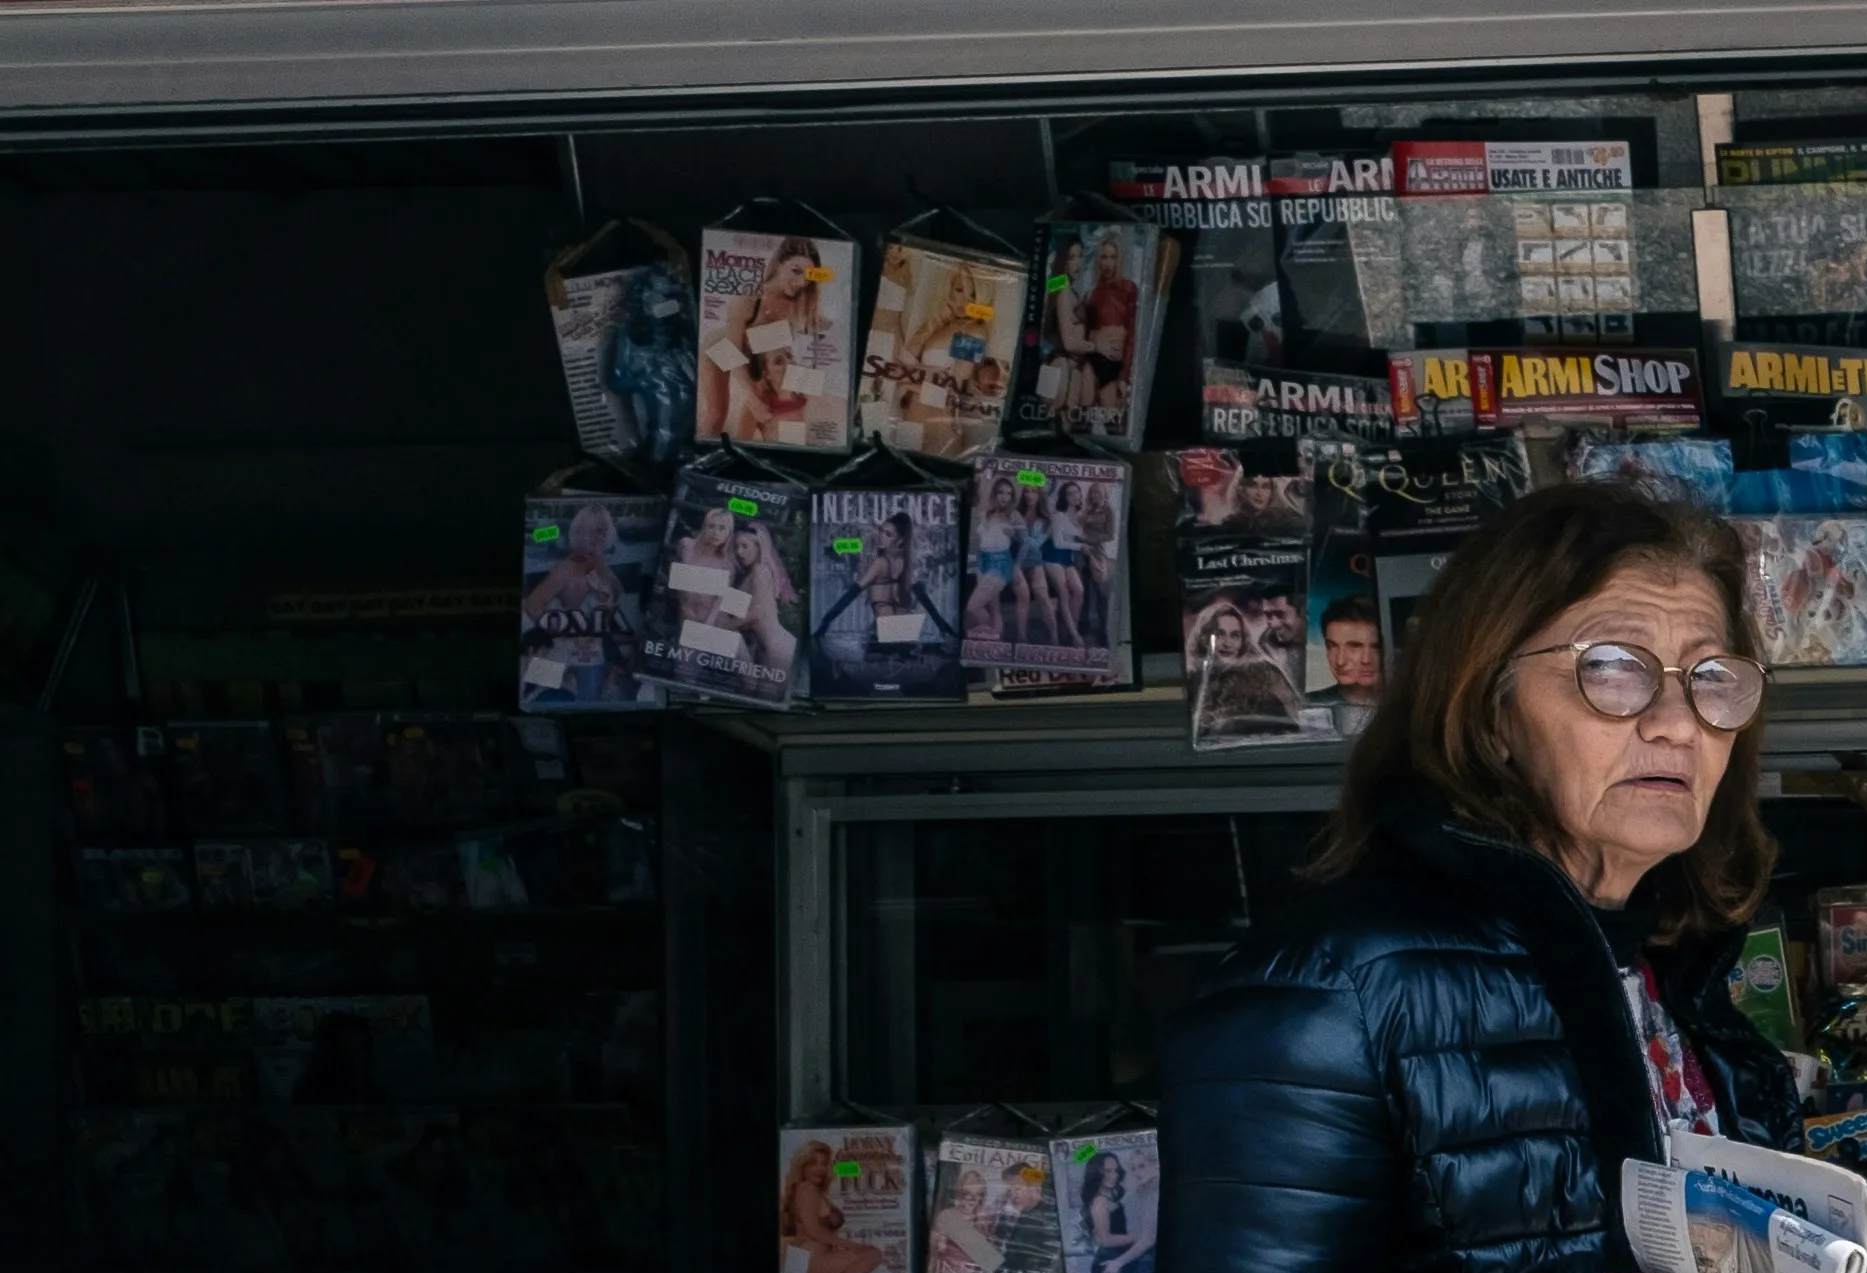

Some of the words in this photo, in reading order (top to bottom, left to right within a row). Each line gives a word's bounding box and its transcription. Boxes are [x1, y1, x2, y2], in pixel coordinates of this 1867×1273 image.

[1163, 161, 1262, 199] ARMI
[1491, 167, 1540, 190] USATE
[1544, 167, 1552, 189] E
[1556, 166, 1623, 189] ANTICHE
[809, 491, 960, 527] INFLUENCE
[1196, 553, 1227, 570] Last
